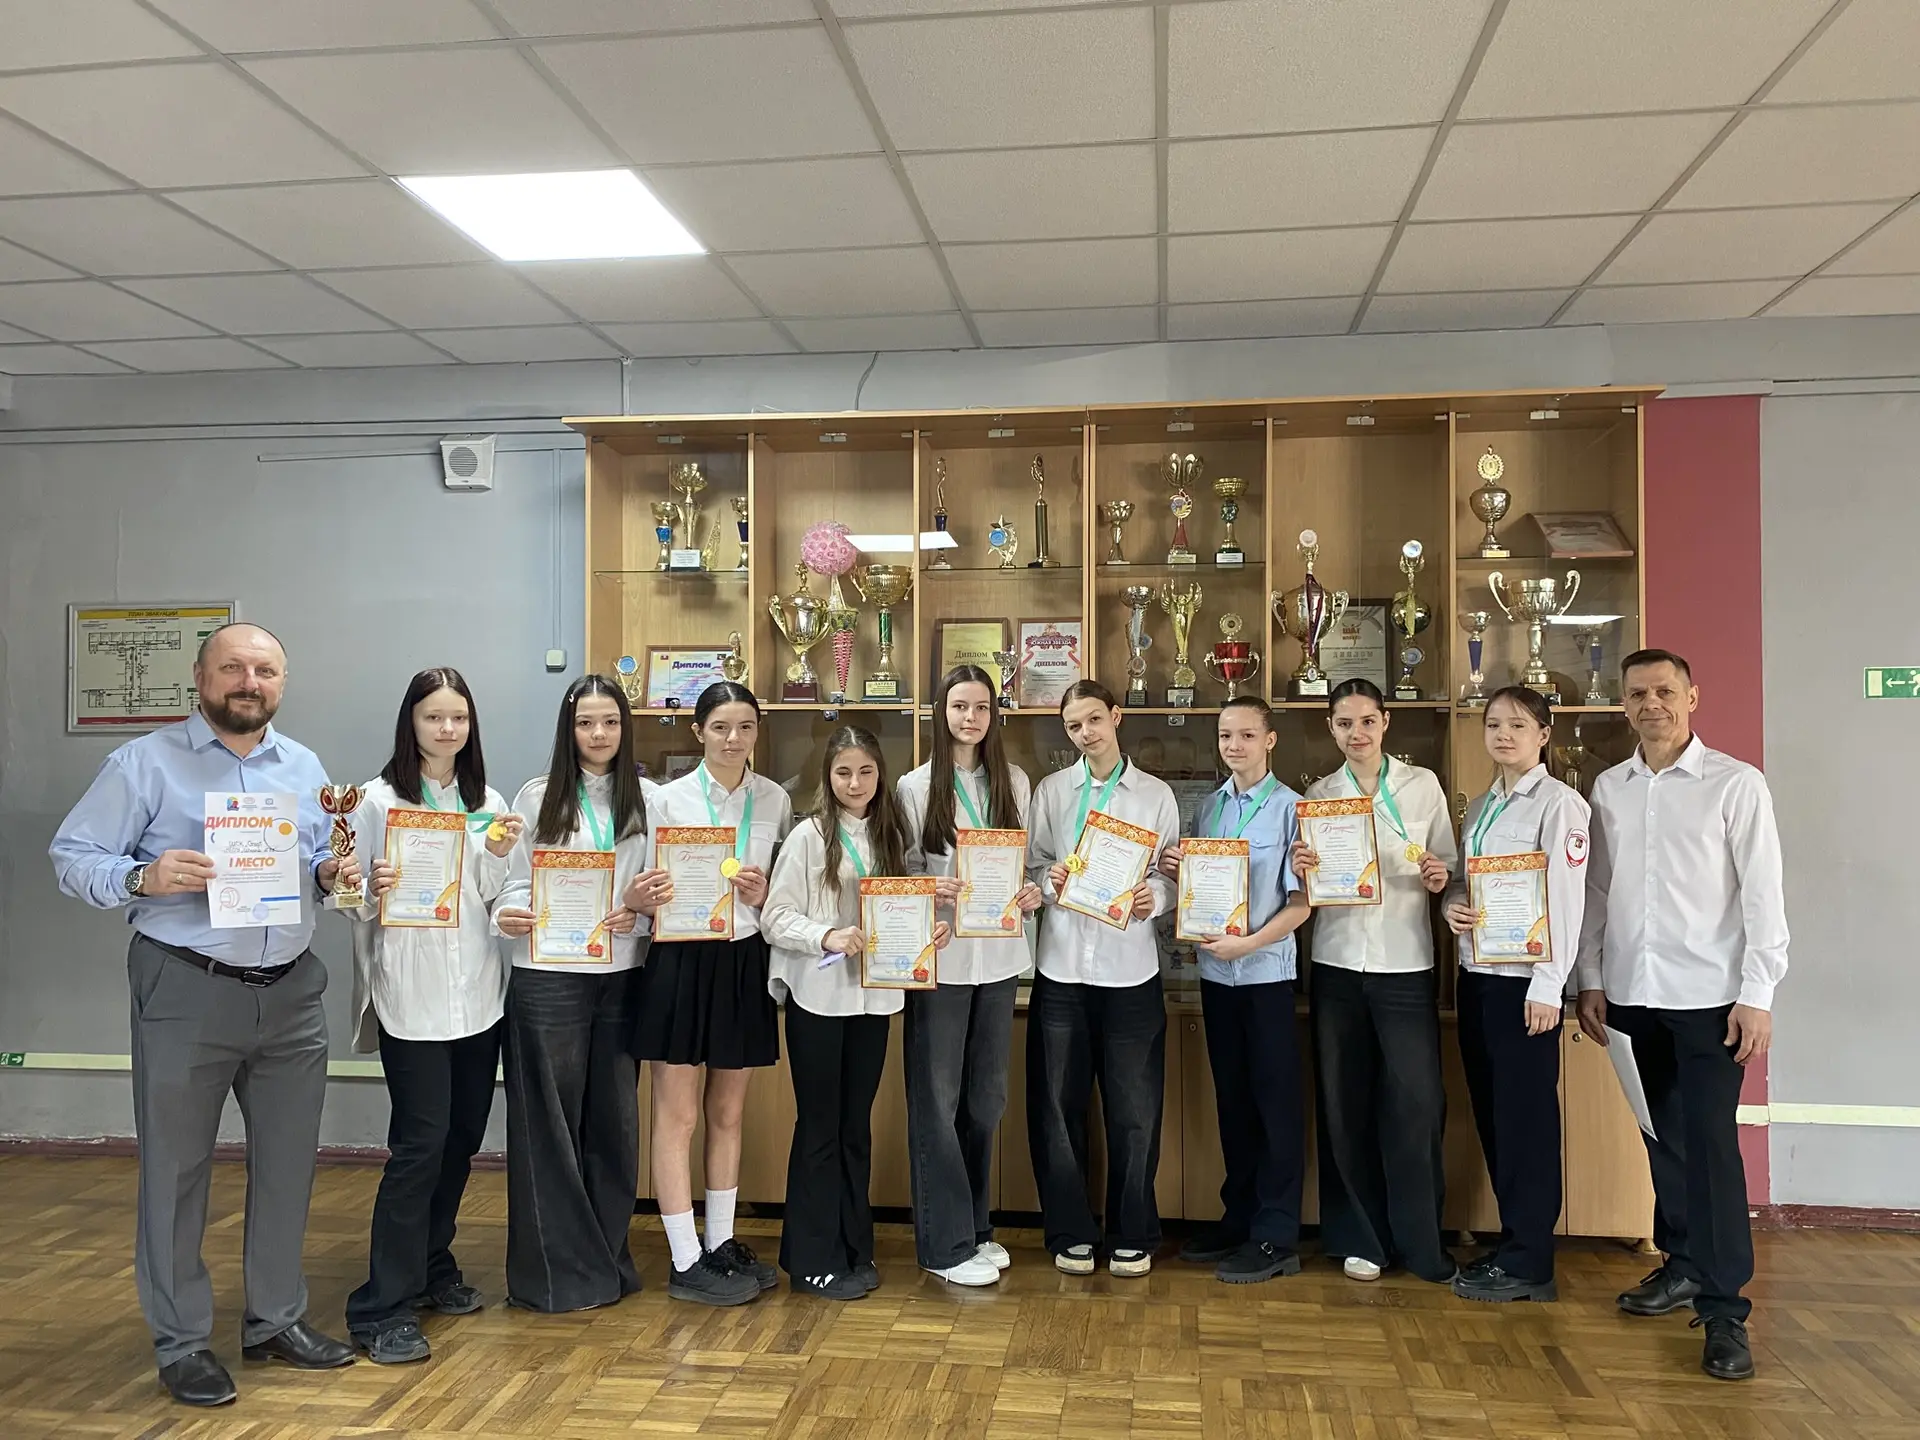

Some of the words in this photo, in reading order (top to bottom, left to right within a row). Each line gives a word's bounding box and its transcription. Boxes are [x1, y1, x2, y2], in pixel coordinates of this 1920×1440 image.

[954, 650, 988, 660] Диплом
[672, 661, 711, 669] Диплом
[1034, 660, 1068, 668] ДИПЛОМ
[205, 816, 273, 830] ДИПЛОМ
[236, 857, 275, 867] МЕСТО
